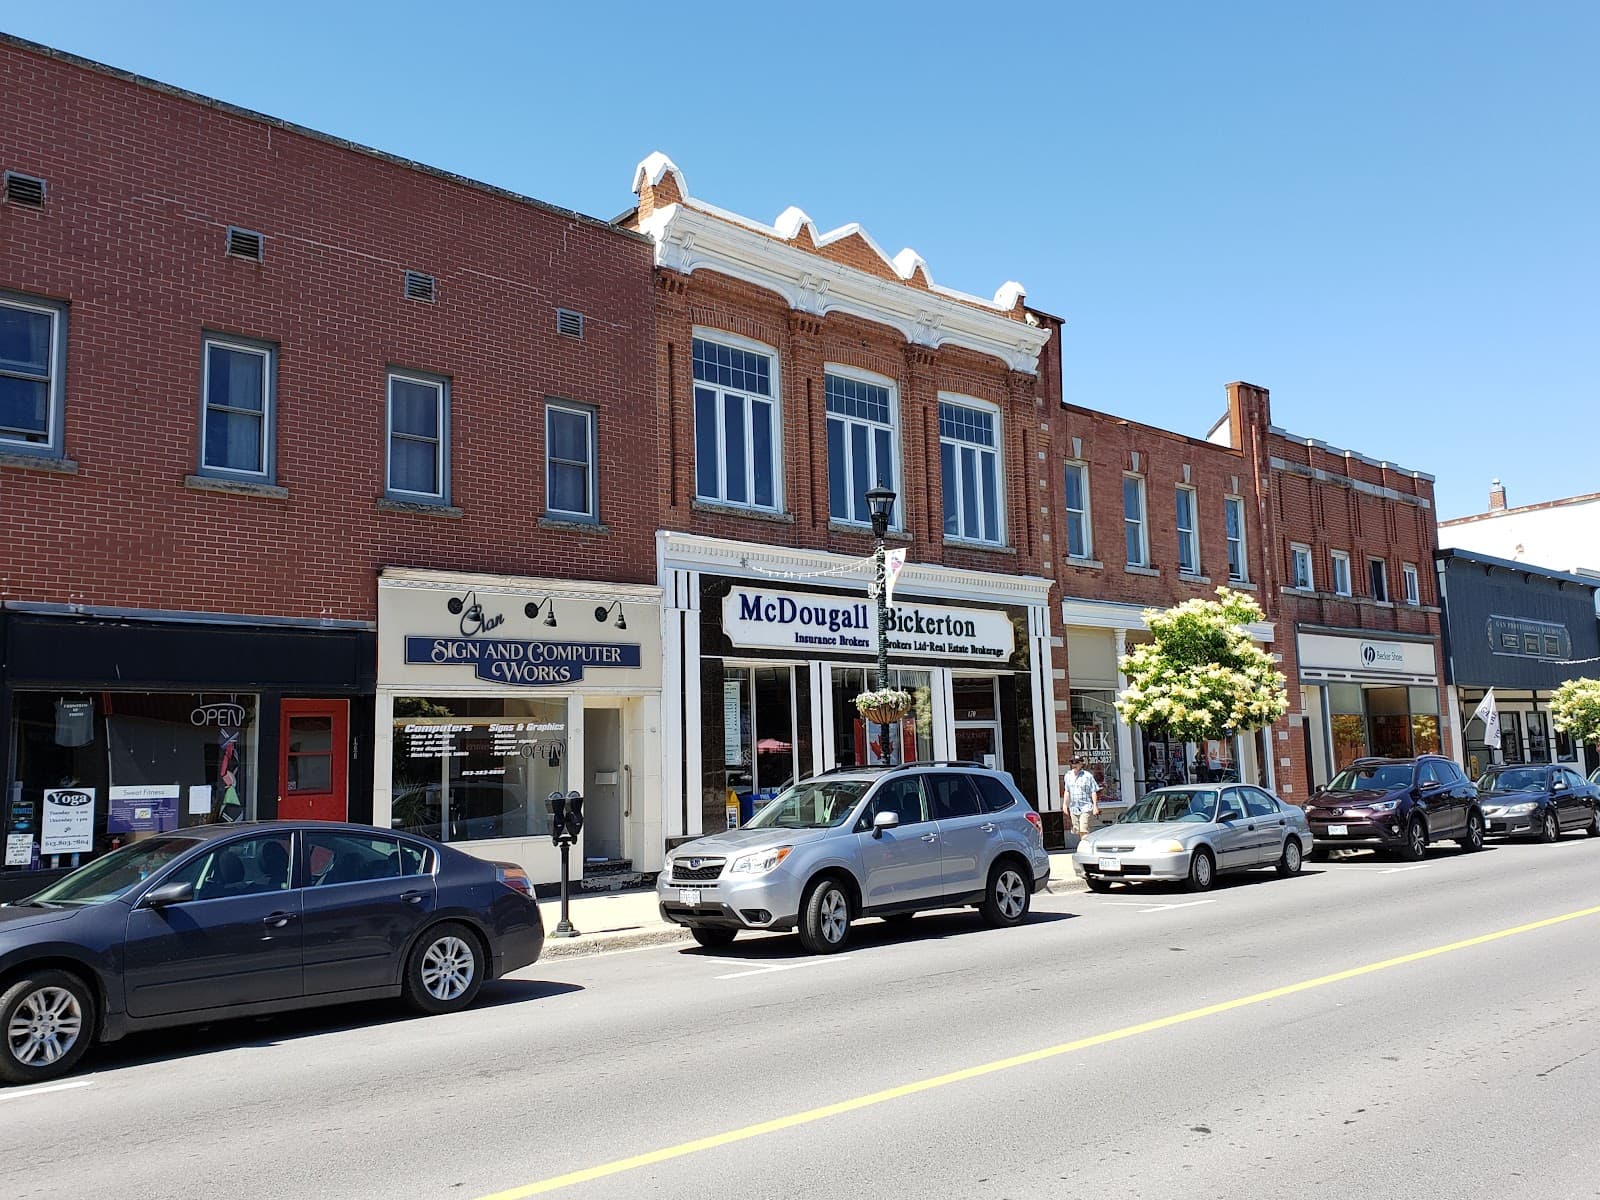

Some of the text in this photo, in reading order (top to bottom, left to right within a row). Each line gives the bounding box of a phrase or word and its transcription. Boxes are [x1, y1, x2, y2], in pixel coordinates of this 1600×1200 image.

[738, 593, 869, 632] McDougall
[885, 608, 976, 638] Bickerton
[794, 632, 870, 648] Insurance Brokers
[431, 640, 621, 664] SIGN AND COMPUTER
[948, 643, 969, 654] Estate
[970, 644, 1004, 658] Brokerage
[491, 661, 571, 682] WORKS
[190, 708, 242, 726] OPEN
[404, 724, 474, 734] Computers
[488, 723, 515, 733] Signs
[526, 722, 565, 732] Graphics
[1073, 732, 1112, 750] SILK
[521, 742, 563, 760] OPEN
[52, 792, 88, 806] Yoga
